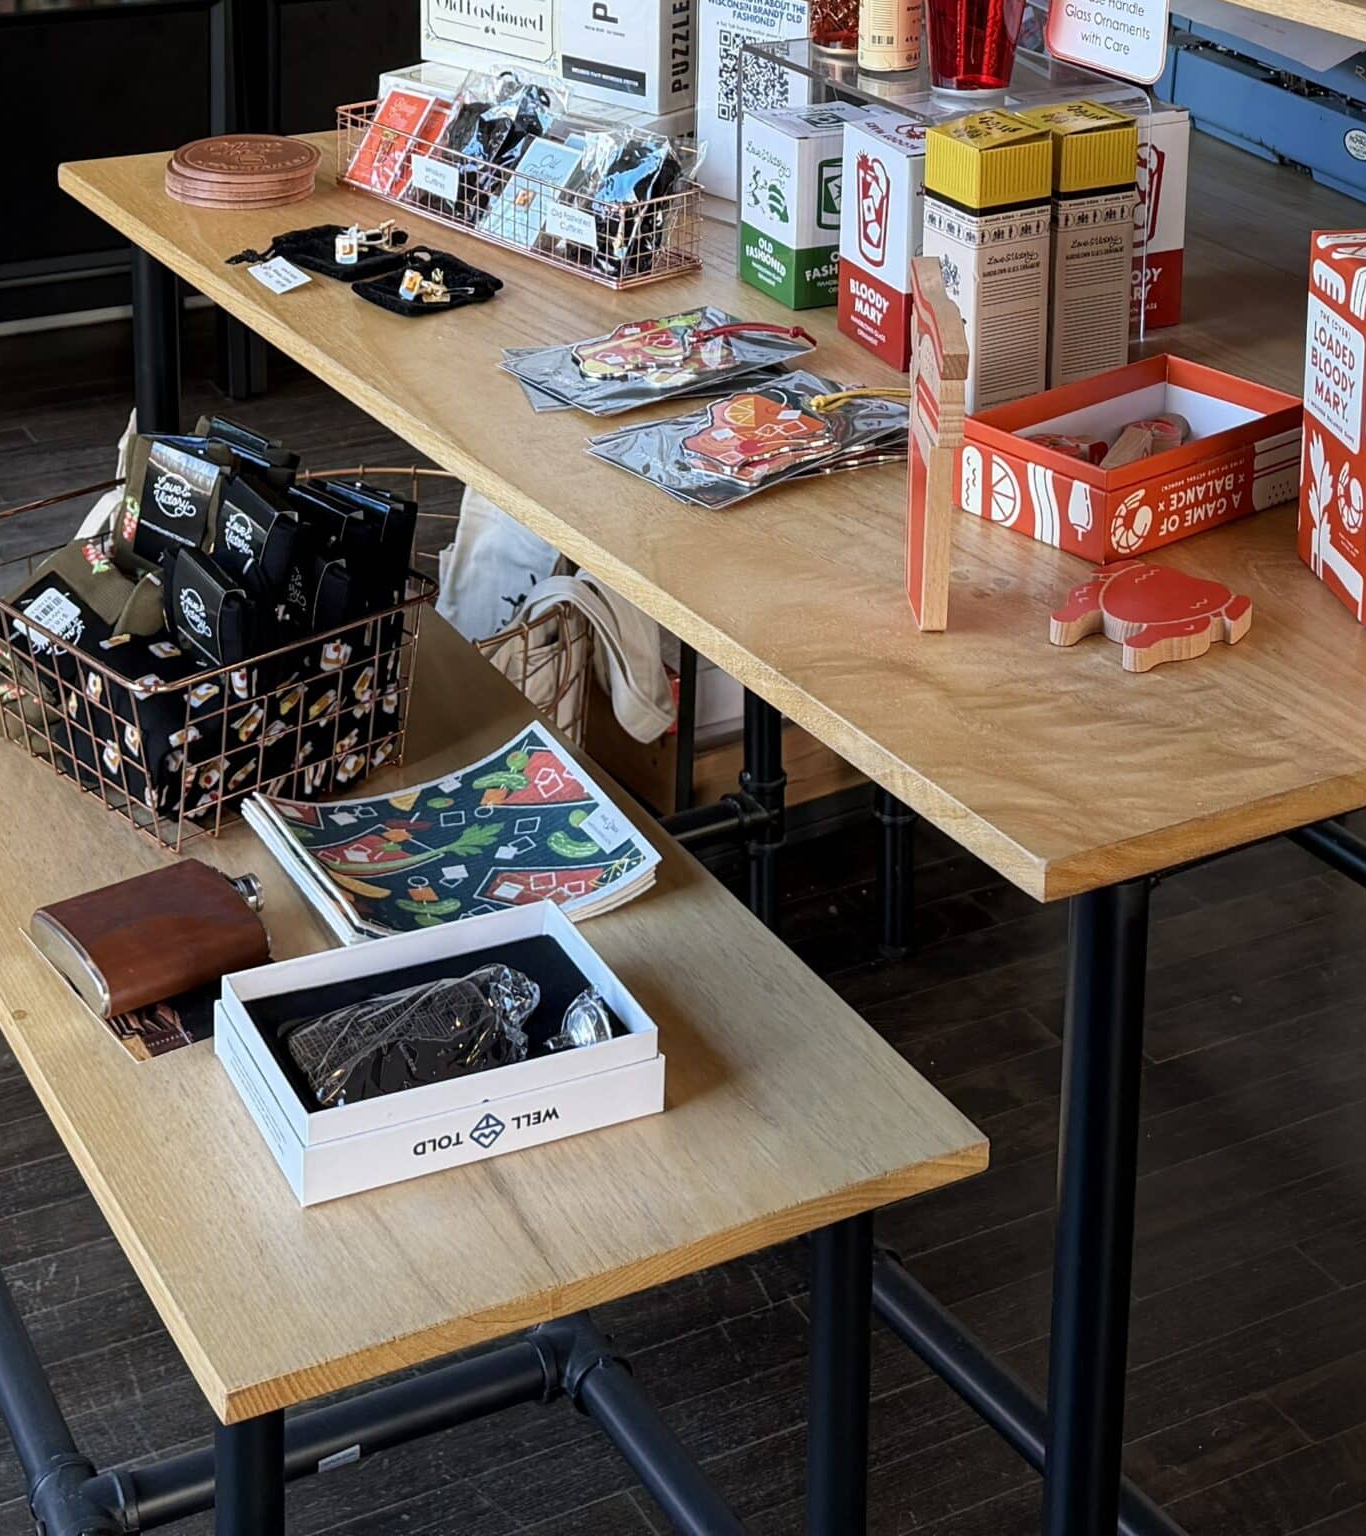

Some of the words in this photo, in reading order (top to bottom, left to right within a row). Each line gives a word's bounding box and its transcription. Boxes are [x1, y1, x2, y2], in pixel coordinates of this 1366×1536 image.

[732, 10, 776, 28] FASHIONED
[753, 4, 784, 20] BRANDY
[786, 13, 803, 24] OLD
[792, 4, 806, 15] THE
[1065, 4, 1092, 23] Glass
[1093, 12, 1150, 40] Ornaments
[671, 0, 690, 94] PUZZLE
[1080, 30, 1102, 47] with
[1104, 37, 1130, 56] Care
[758, 237, 773, 255] OLD
[746, 244, 786, 278] FASHIONED
[849, 278, 889, 314] BLOODY
[854, 298, 884, 326] MARY
[1314, 320, 1355, 371] LOADED
[1311, 345, 1355, 399] BLOODY
[1315, 375, 1348, 423] MARY.
[1169, 473, 1235, 512] BALANCE
[1232, 491, 1242, 508] A
[1158, 515, 1180, 537] OF
[1184, 497, 1227, 527] GAME
[511, 1107, 560, 1129] WELL
[413, 1131, 464, 1156] TOLD
